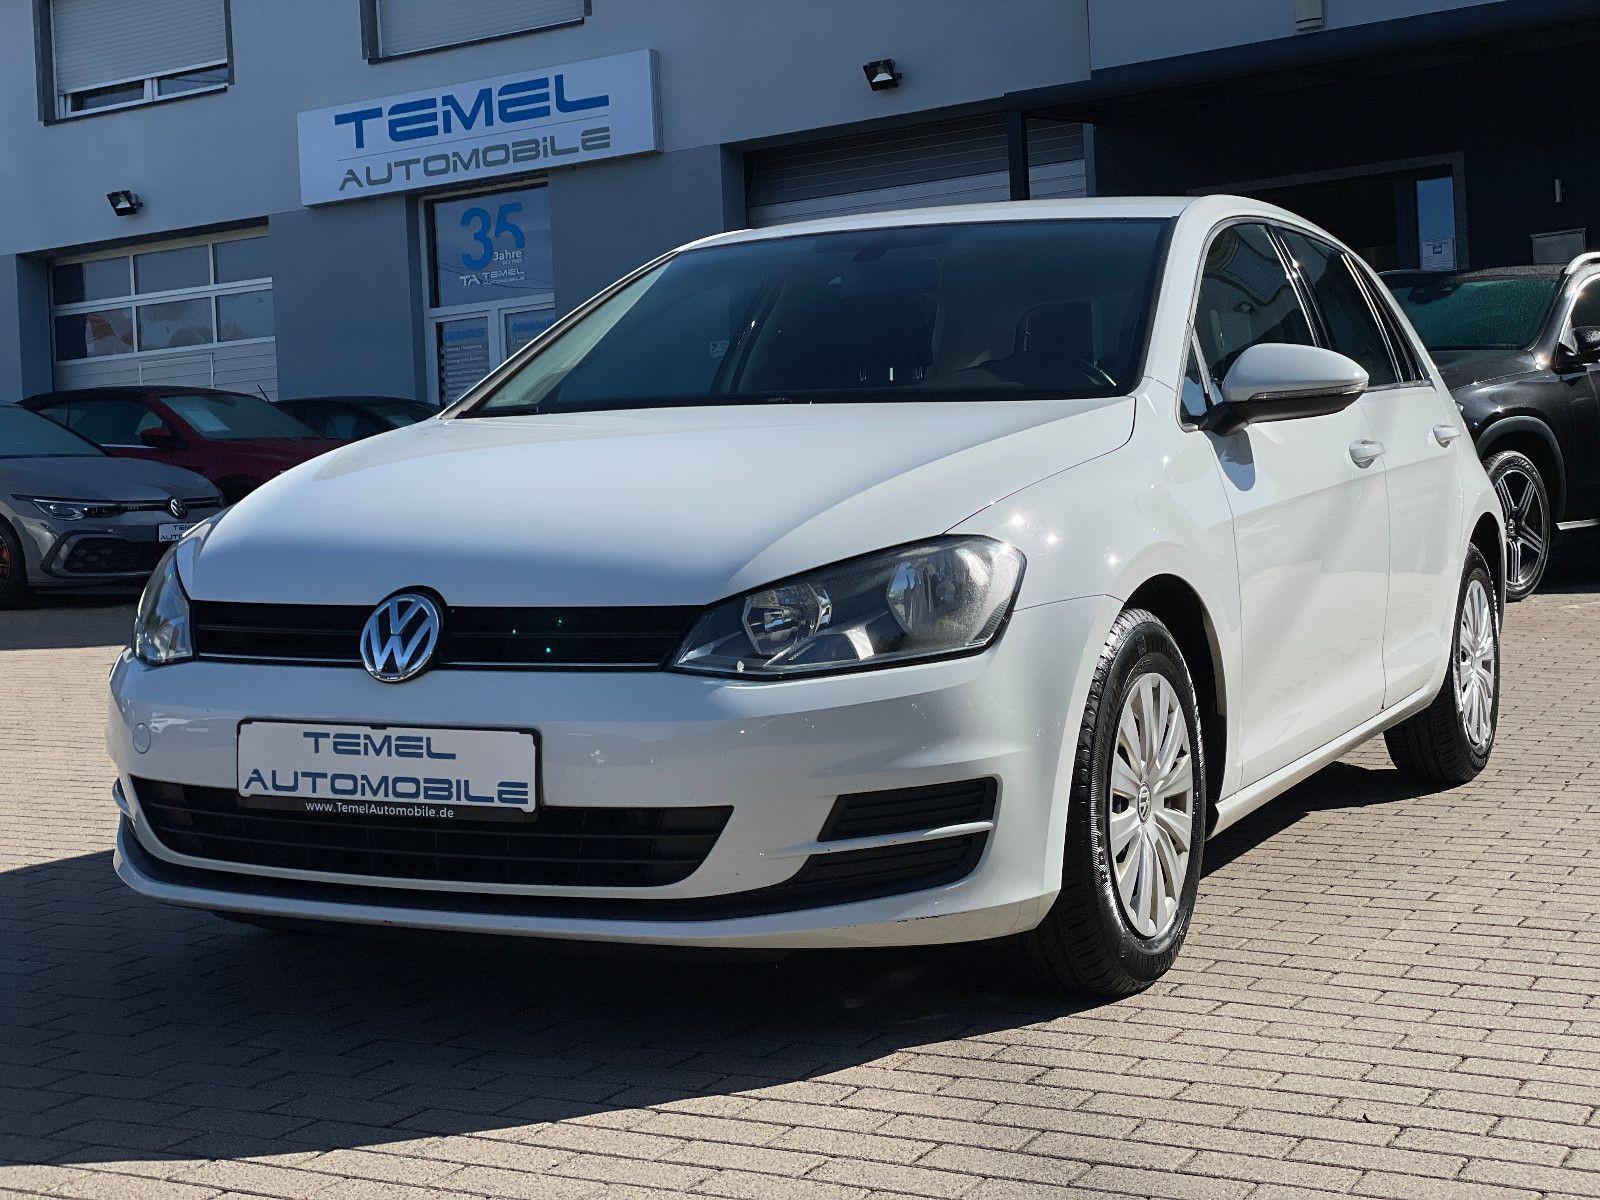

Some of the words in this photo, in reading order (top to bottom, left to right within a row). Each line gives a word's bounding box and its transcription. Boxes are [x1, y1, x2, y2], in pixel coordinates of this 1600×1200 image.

[334, 74, 610, 149] TEMEL
[460, 202, 525, 270] 35
[493, 250, 522, 261] Jahre
[481, 268, 525, 279] TEMEL
[303, 731, 457, 760] TEMEL
[244, 768, 529, 805] AUTOMOBILE
[305, 802, 454, 818] www.TemelAutomobile.de
